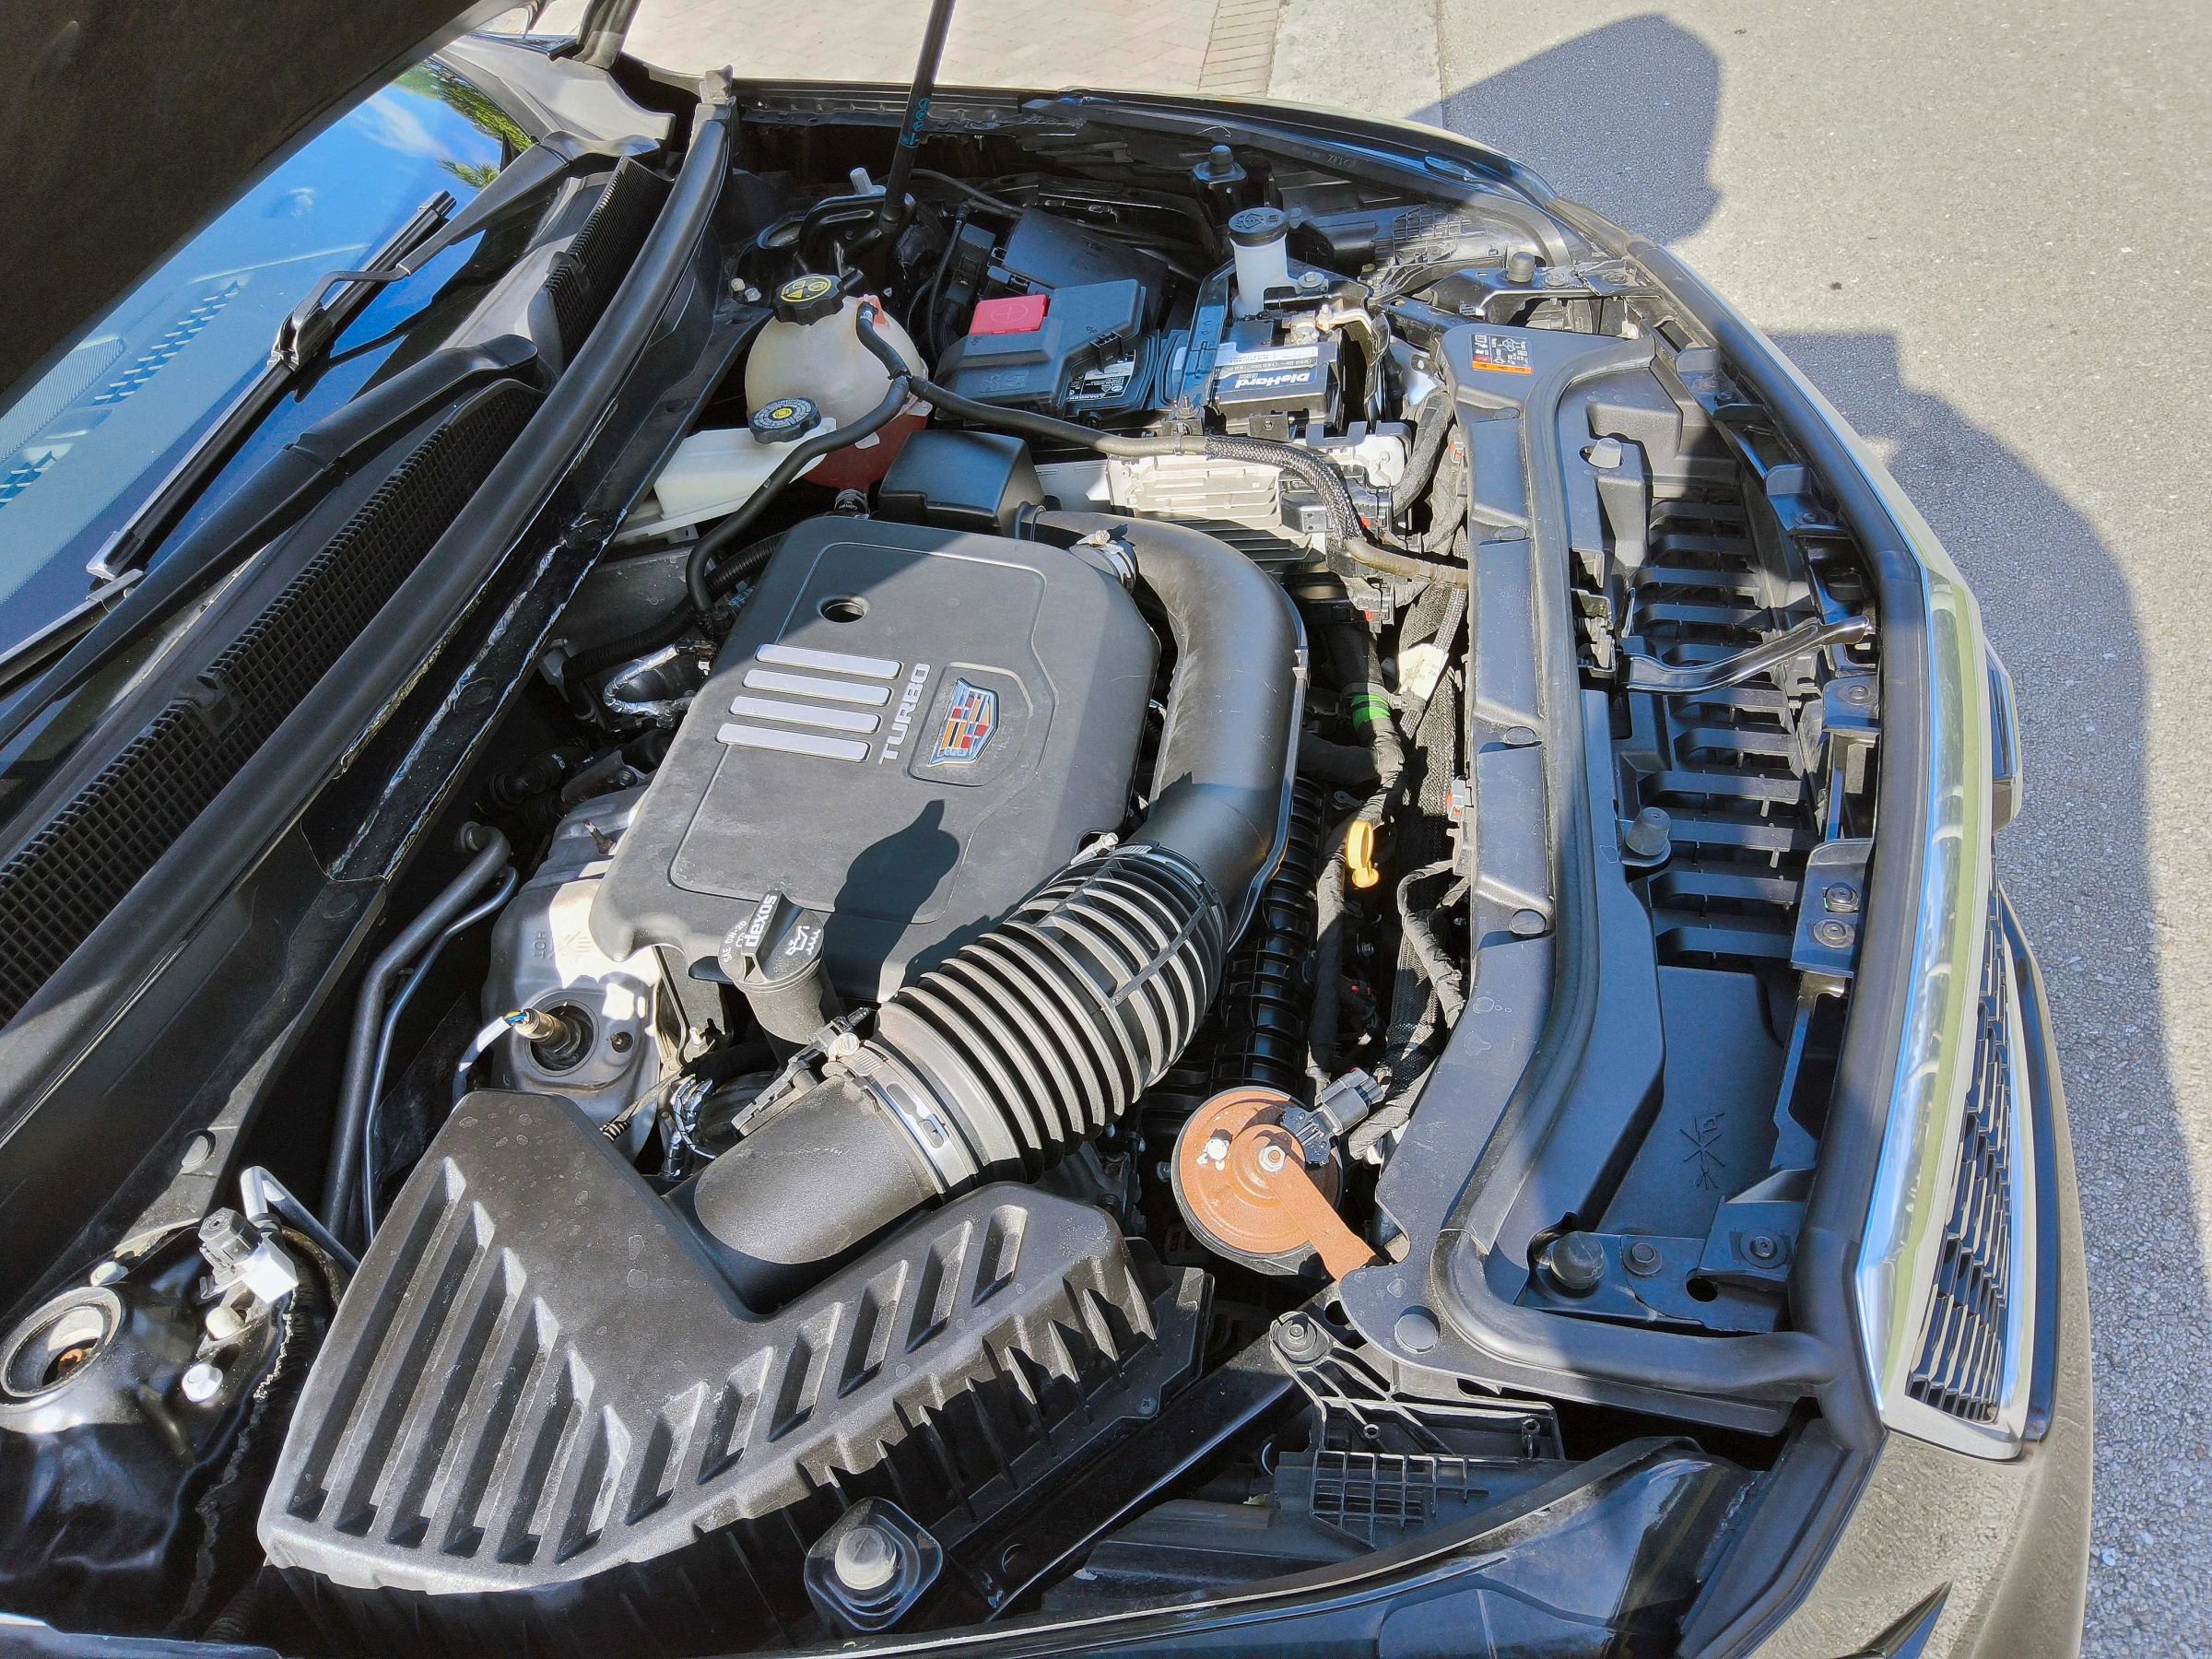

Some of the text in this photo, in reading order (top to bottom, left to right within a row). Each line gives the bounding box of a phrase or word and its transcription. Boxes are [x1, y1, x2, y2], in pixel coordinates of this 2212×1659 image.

[1235, 372, 1311, 389] DieHard
[878, 663, 931, 764] TURBO
[744, 894, 778, 947] dexos
[532, 930, 547, 959] HOT
[722, 921, 747, 963] SAE 0W-20
